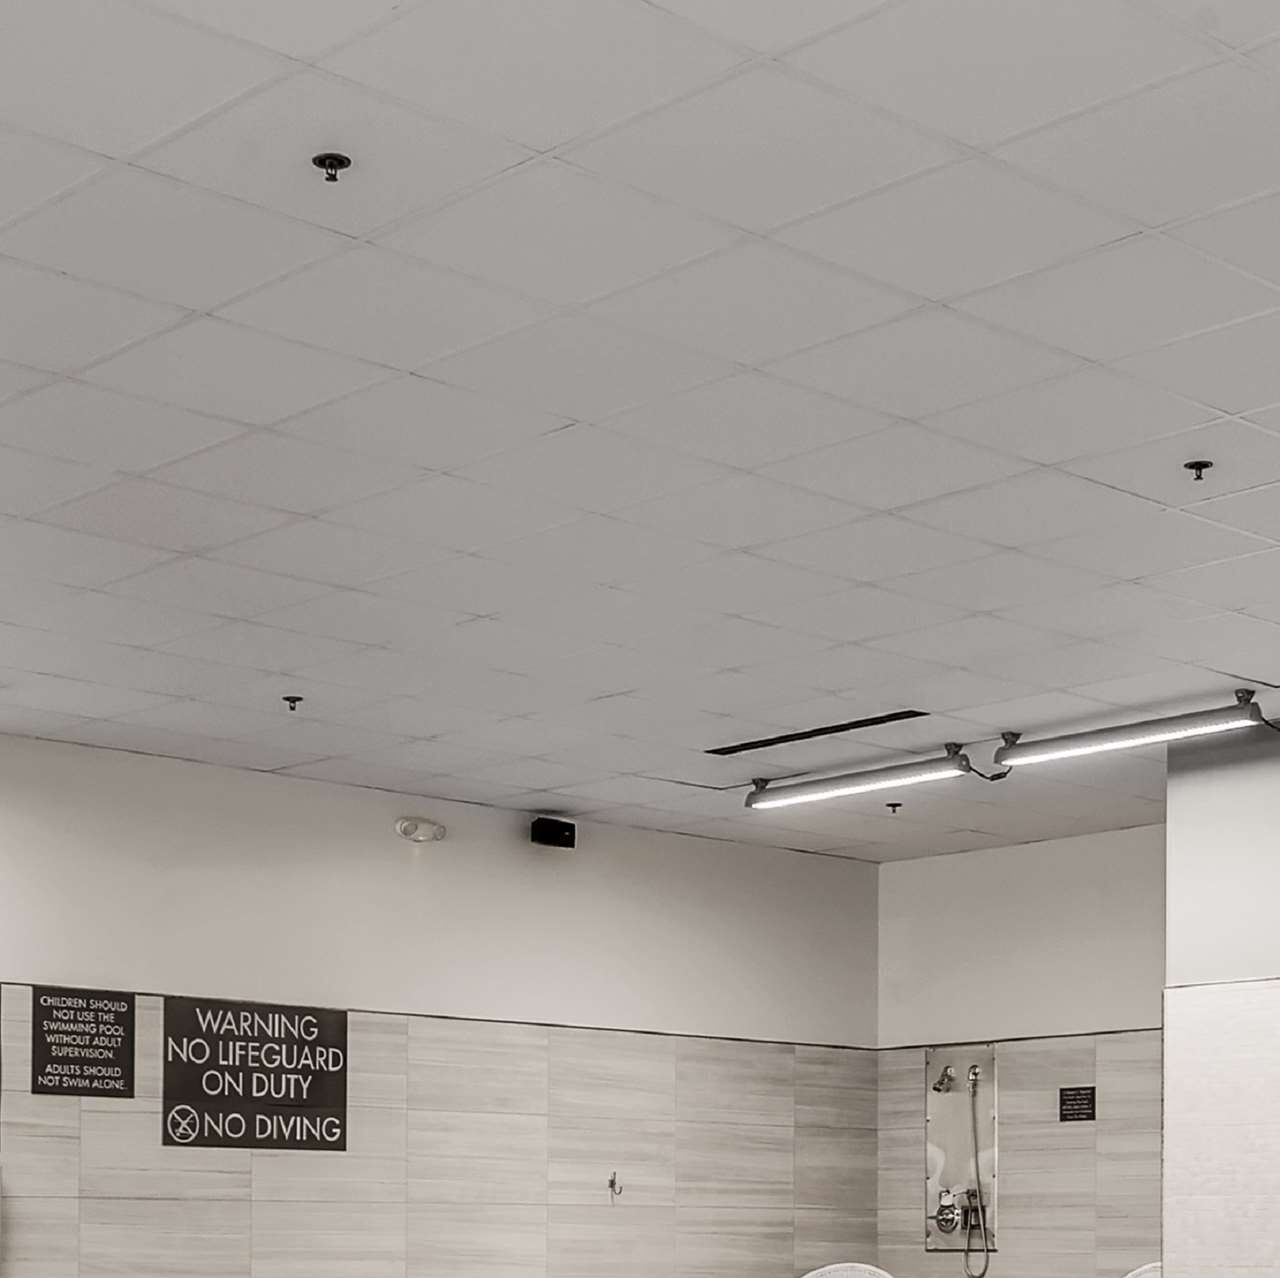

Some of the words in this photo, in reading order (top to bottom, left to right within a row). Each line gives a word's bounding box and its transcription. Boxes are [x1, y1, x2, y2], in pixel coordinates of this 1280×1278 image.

[40, 996, 87, 1009] CHILDREN
[89, 999, 128, 1012] SHOULD
[53, 1009, 75, 1020] NOT
[77, 1011, 95, 1022] USE
[98, 1012, 116, 1023] THE
[196, 1007, 319, 1041] WARNING
[42, 1020, 97, 1034] SWIMMING
[99, 1024, 125, 1036] POOL
[45, 1033, 90, 1046] WITHOUT
[92, 1036, 122, 1048] ADULT
[167, 1036, 210, 1064] NO
[219, 1040, 344, 1072] LIFEGUARD
[45, 1064, 80, 1075] ADULTS
[83, 1065, 122, 1077] SHOULD
[38, 1075, 60, 1086] NOT
[62, 1076, 90, 1088] SWIM
[202, 1070, 243, 1097] ON
[252, 1072, 312, 1099] DUTY
[204, 1112, 246, 1138] NO
[255, 1114, 342, 1142] DIVING
